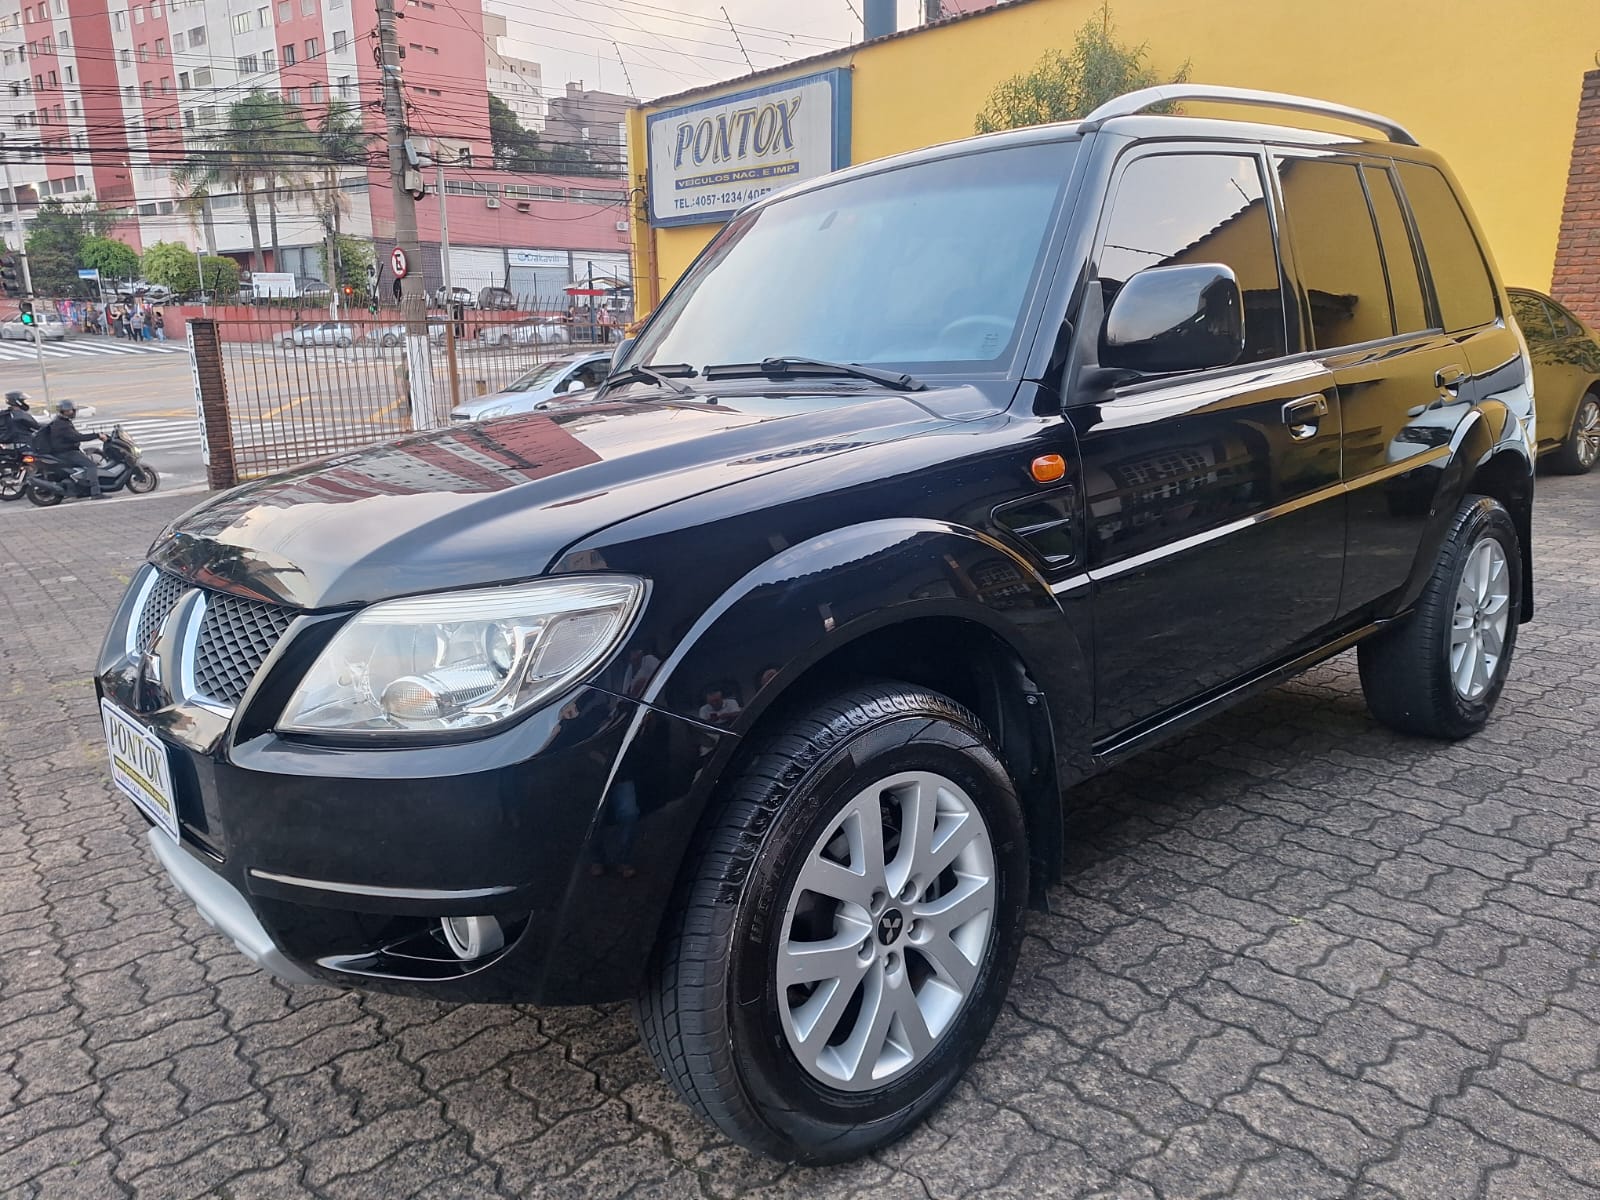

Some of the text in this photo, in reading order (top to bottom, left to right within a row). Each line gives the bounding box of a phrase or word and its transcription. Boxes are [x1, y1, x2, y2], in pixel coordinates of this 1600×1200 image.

[674, 96, 801, 170] PONTOX
[733, 170, 760, 181] NAC.
[762, 168, 770, 176] E
[773, 164, 797, 175] IMP.
[110, 716, 165, 790] PONTOX
